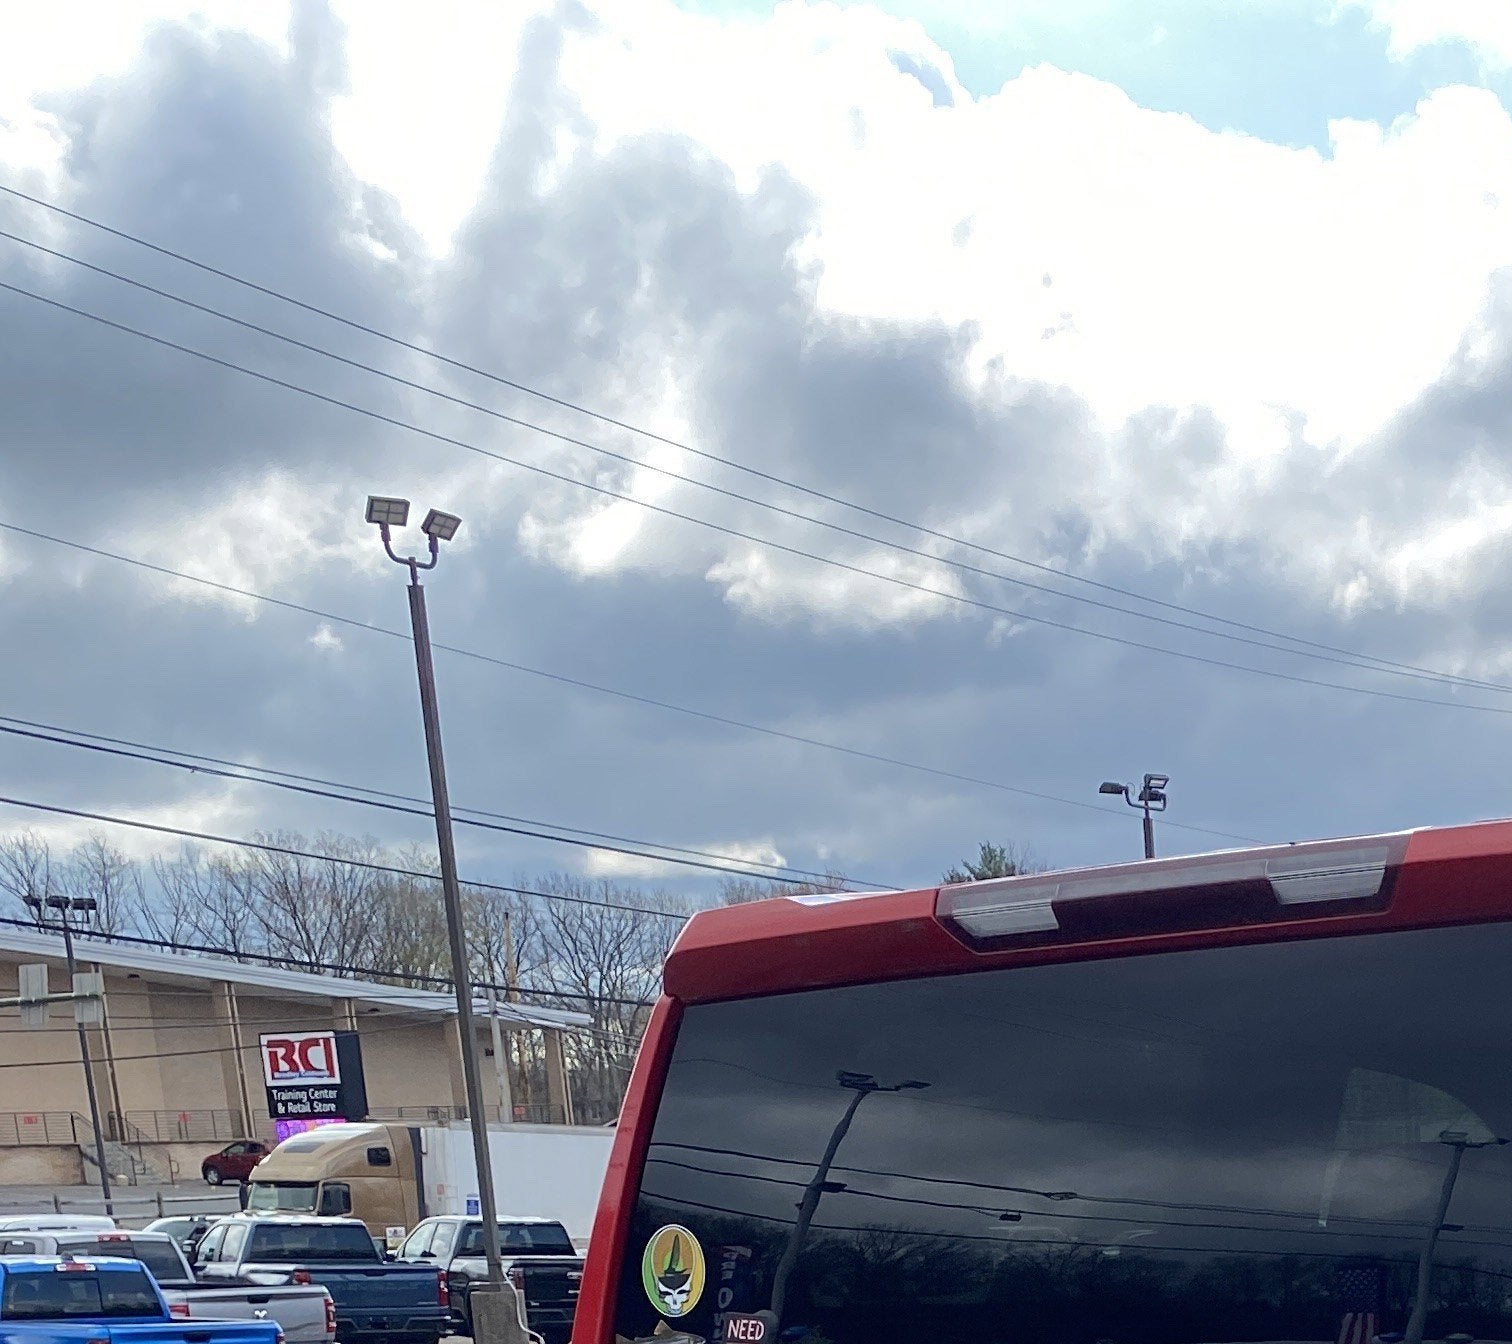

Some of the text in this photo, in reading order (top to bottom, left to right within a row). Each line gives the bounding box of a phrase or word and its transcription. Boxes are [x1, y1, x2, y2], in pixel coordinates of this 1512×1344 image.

[272, 1088, 338, 1102] Training Center
[277, 1101, 336, 1114] & Retail Store
[728, 1319, 765, 1340] NEED
